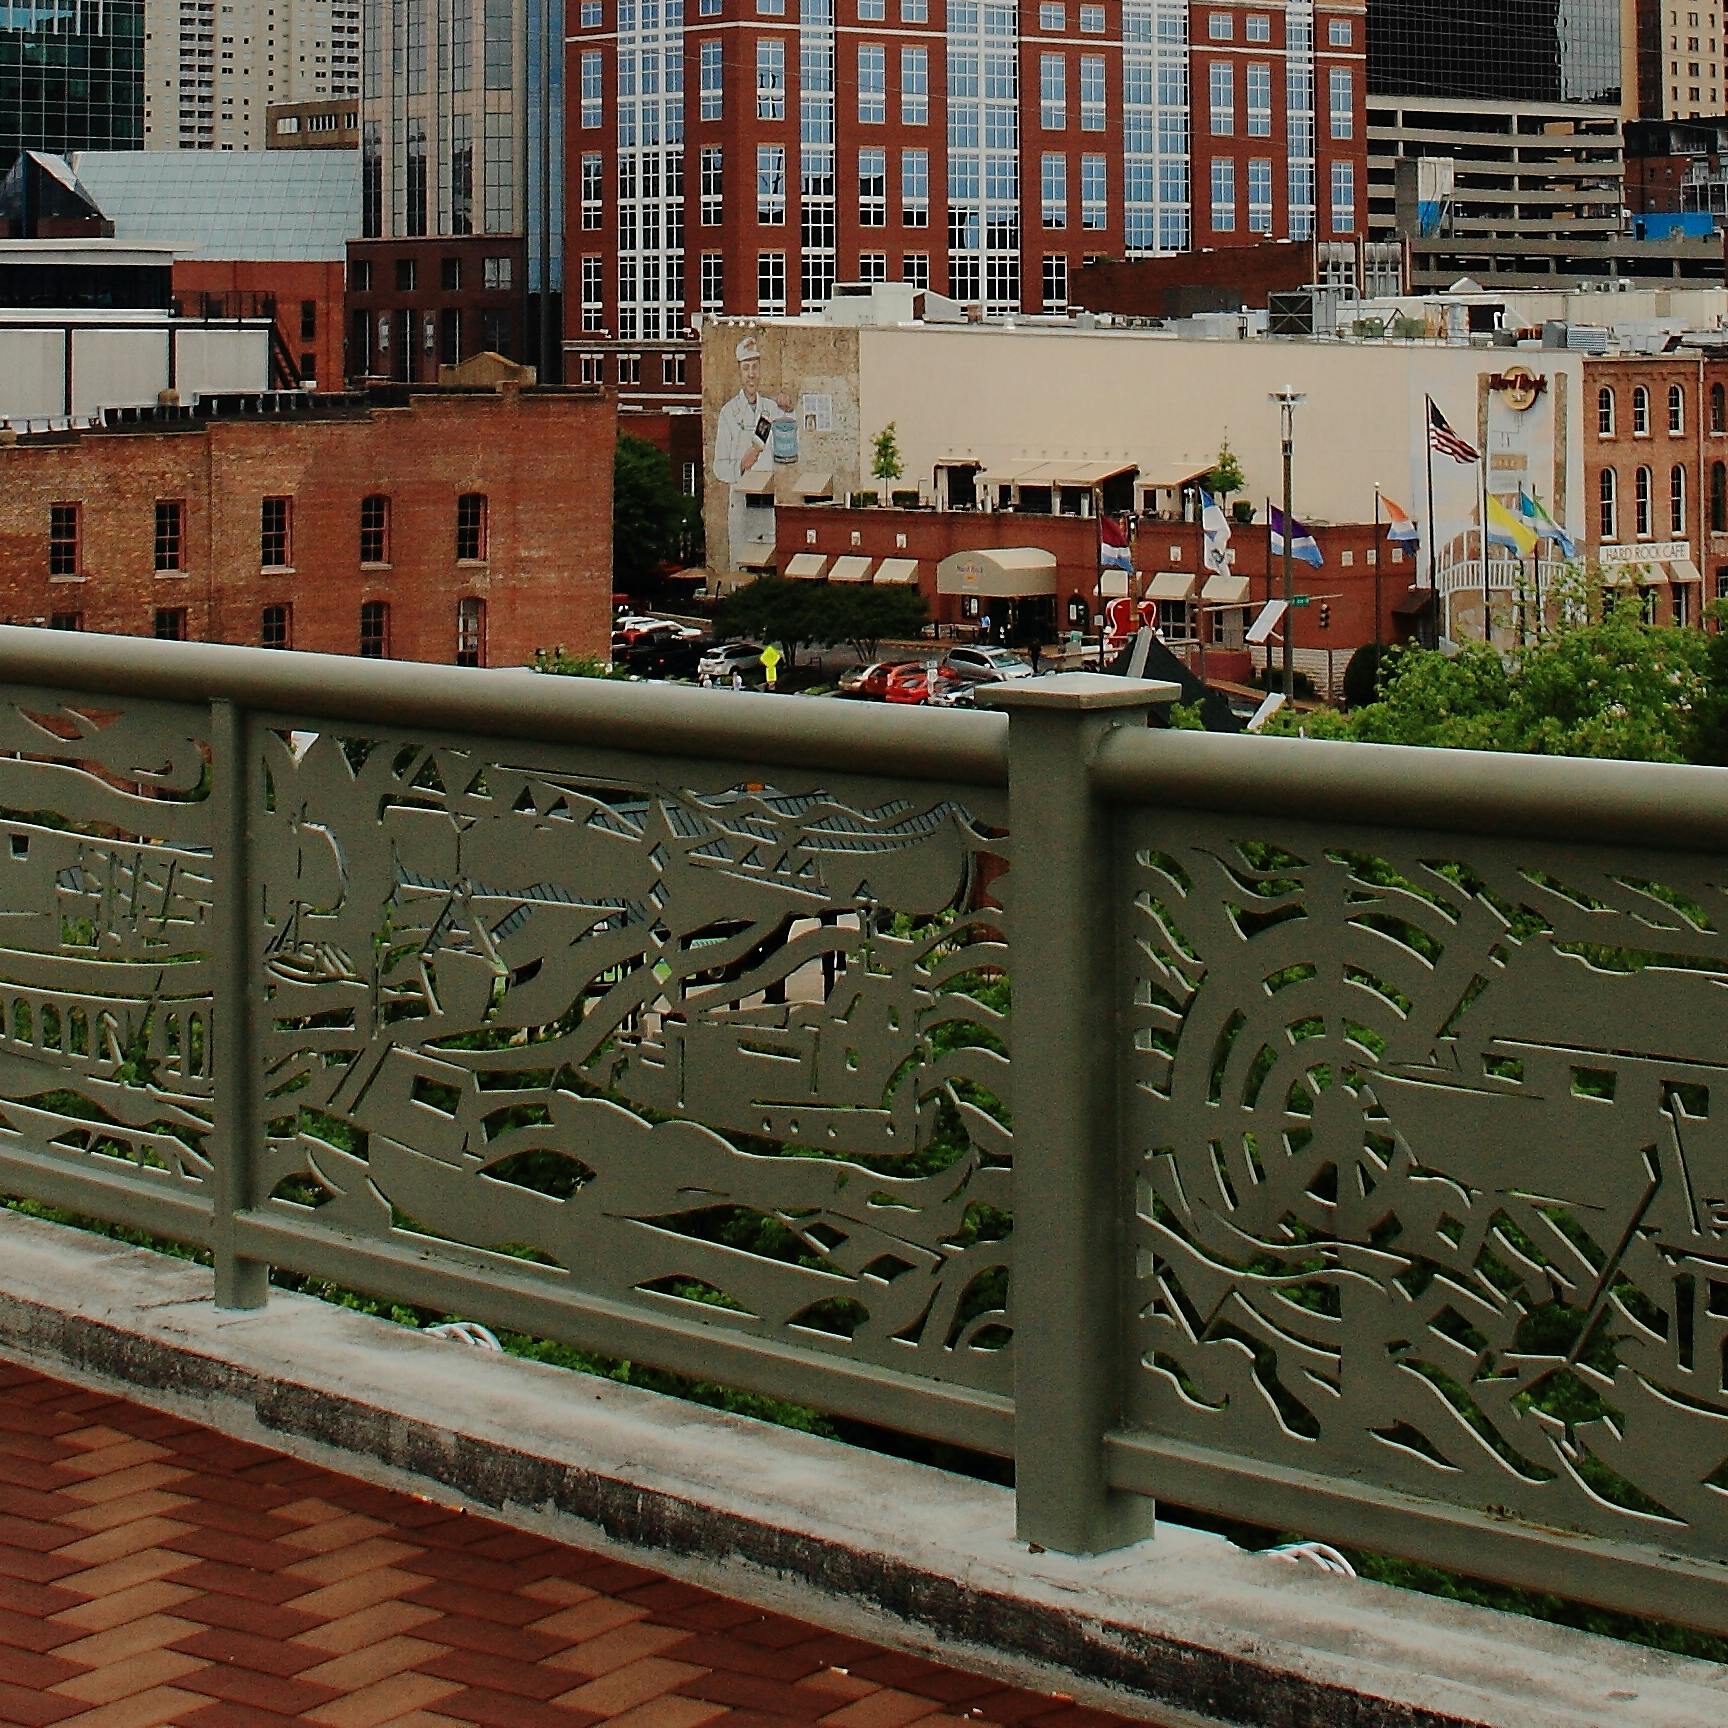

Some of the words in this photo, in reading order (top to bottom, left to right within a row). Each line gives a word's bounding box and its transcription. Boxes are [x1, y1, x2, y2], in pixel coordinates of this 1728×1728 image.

[1606, 547, 1633, 562] HARD
[1634, 545, 1661, 560] ROCK
[1663, 543, 1686, 558] CAFE
